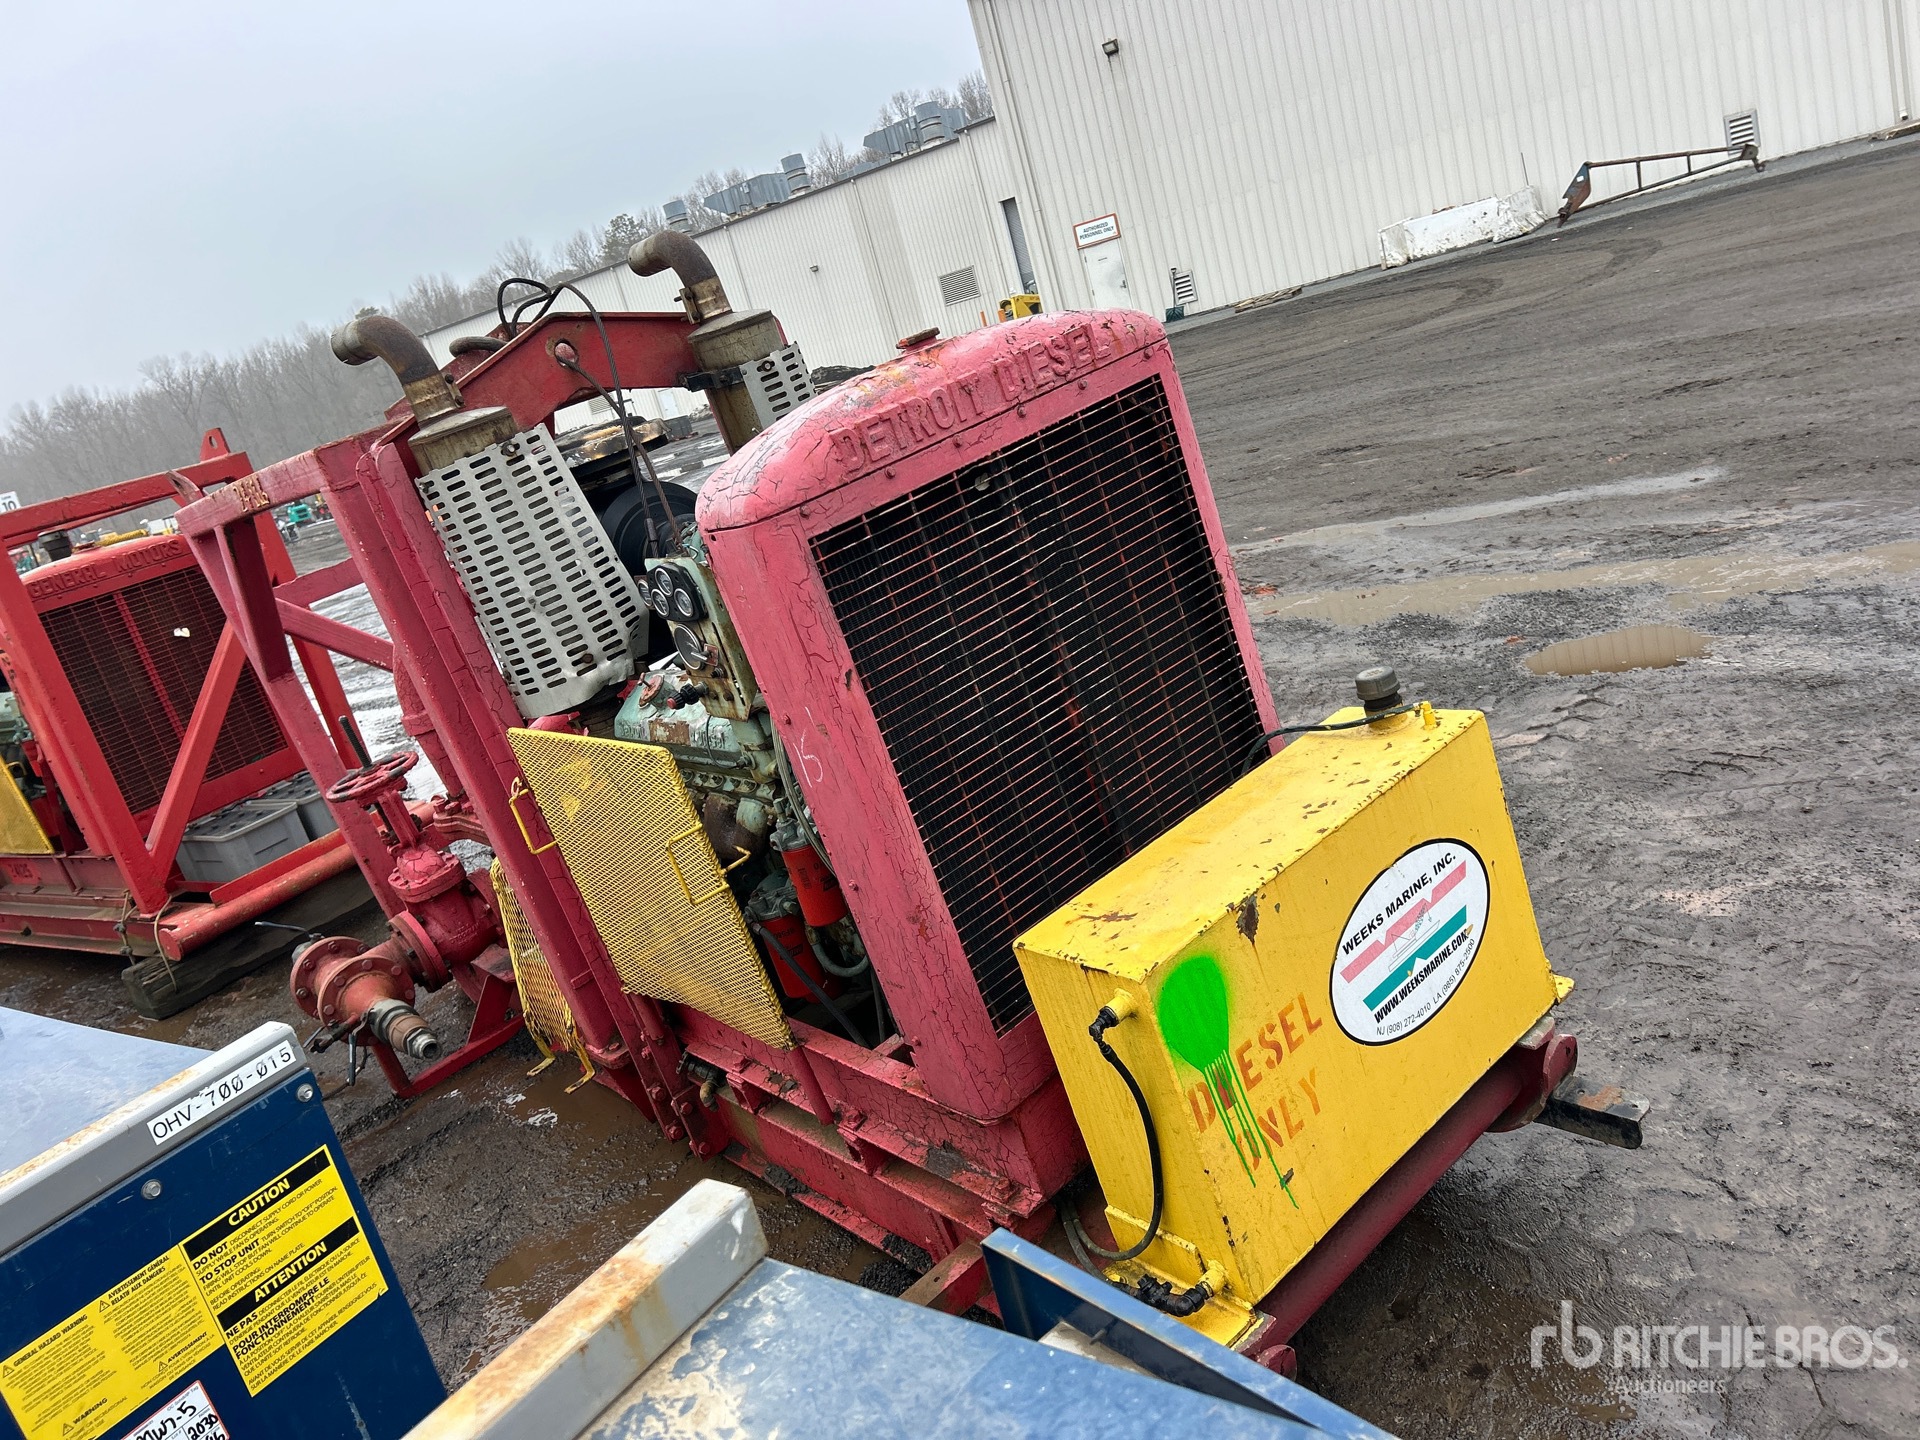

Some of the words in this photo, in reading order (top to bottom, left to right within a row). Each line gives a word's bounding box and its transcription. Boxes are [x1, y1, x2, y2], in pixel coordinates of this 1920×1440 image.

[1080, 230, 1103, 240] PERSONNEL
[1084, 222, 1108, 232] AUTHORIZED
[831, 369, 984, 474] DETROIT
[993, 322, 1112, 402] DIESEL
[28, 563, 107, 599] GENERAL
[111, 539, 184, 574] MOTORS
[1342, 913, 1384, 956] WEEKS
[1385, 873, 1433, 918] MARINE,
[1433, 852, 1456, 876] INC.
[1376, 1026, 1386, 1036] NJ
[1386, 1021, 1403, 1036] (908)
[1403, 1002, 1432, 1028] 272-4010
[1432, 992, 1442, 1004] LA
[1441, 974, 1458, 998] (985)
[1455, 938, 1476, 976] 875-2500
[153, 1048, 290, 1137] OHV-700-015
[192, 1256, 207, 1270] DO
[208, 1241, 227, 1259] NOT
[229, 1220, 262, 1245] DISCONNECT
[262, 1207, 281, 1222] SUPPLY
[281, 1196, 296, 1209] CORD
[304, 1178, 322, 1193] POWER
[228, 1178, 290, 1226] CAUTION
[108, 1270, 146, 1298] AVERTISSEMENT
[111, 1290, 129, 1305] RELATIF
[131, 1282, 142, 1292] AUX
[142, 1266, 165, 1284] DANGERS
[199, 1272, 212, 1283] TO
[213, 1254, 236, 1274] STOP
[238, 1238, 258, 1256] UNIT
[254, 1241, 327, 1302] ATTENTION
[13, 1348, 37, 1366] GENERAL
[38, 1332, 60, 1349] HAZARD
[62, 1314, 87, 1333] WARNING
[226, 1325, 239, 1338] NE
[239, 1312, 257, 1328] PAS
[232, 1330, 258, 1352] POUR
[258, 1284, 318, 1333] INTERROMPRE
[318, 1276, 329, 1288] LE
[236, 1295, 314, 1358] FONCTIONNEMENT
[168, 1331, 206, 1362] AVERTISSEMENT
[73, 1398, 107, 1423] WARNING
